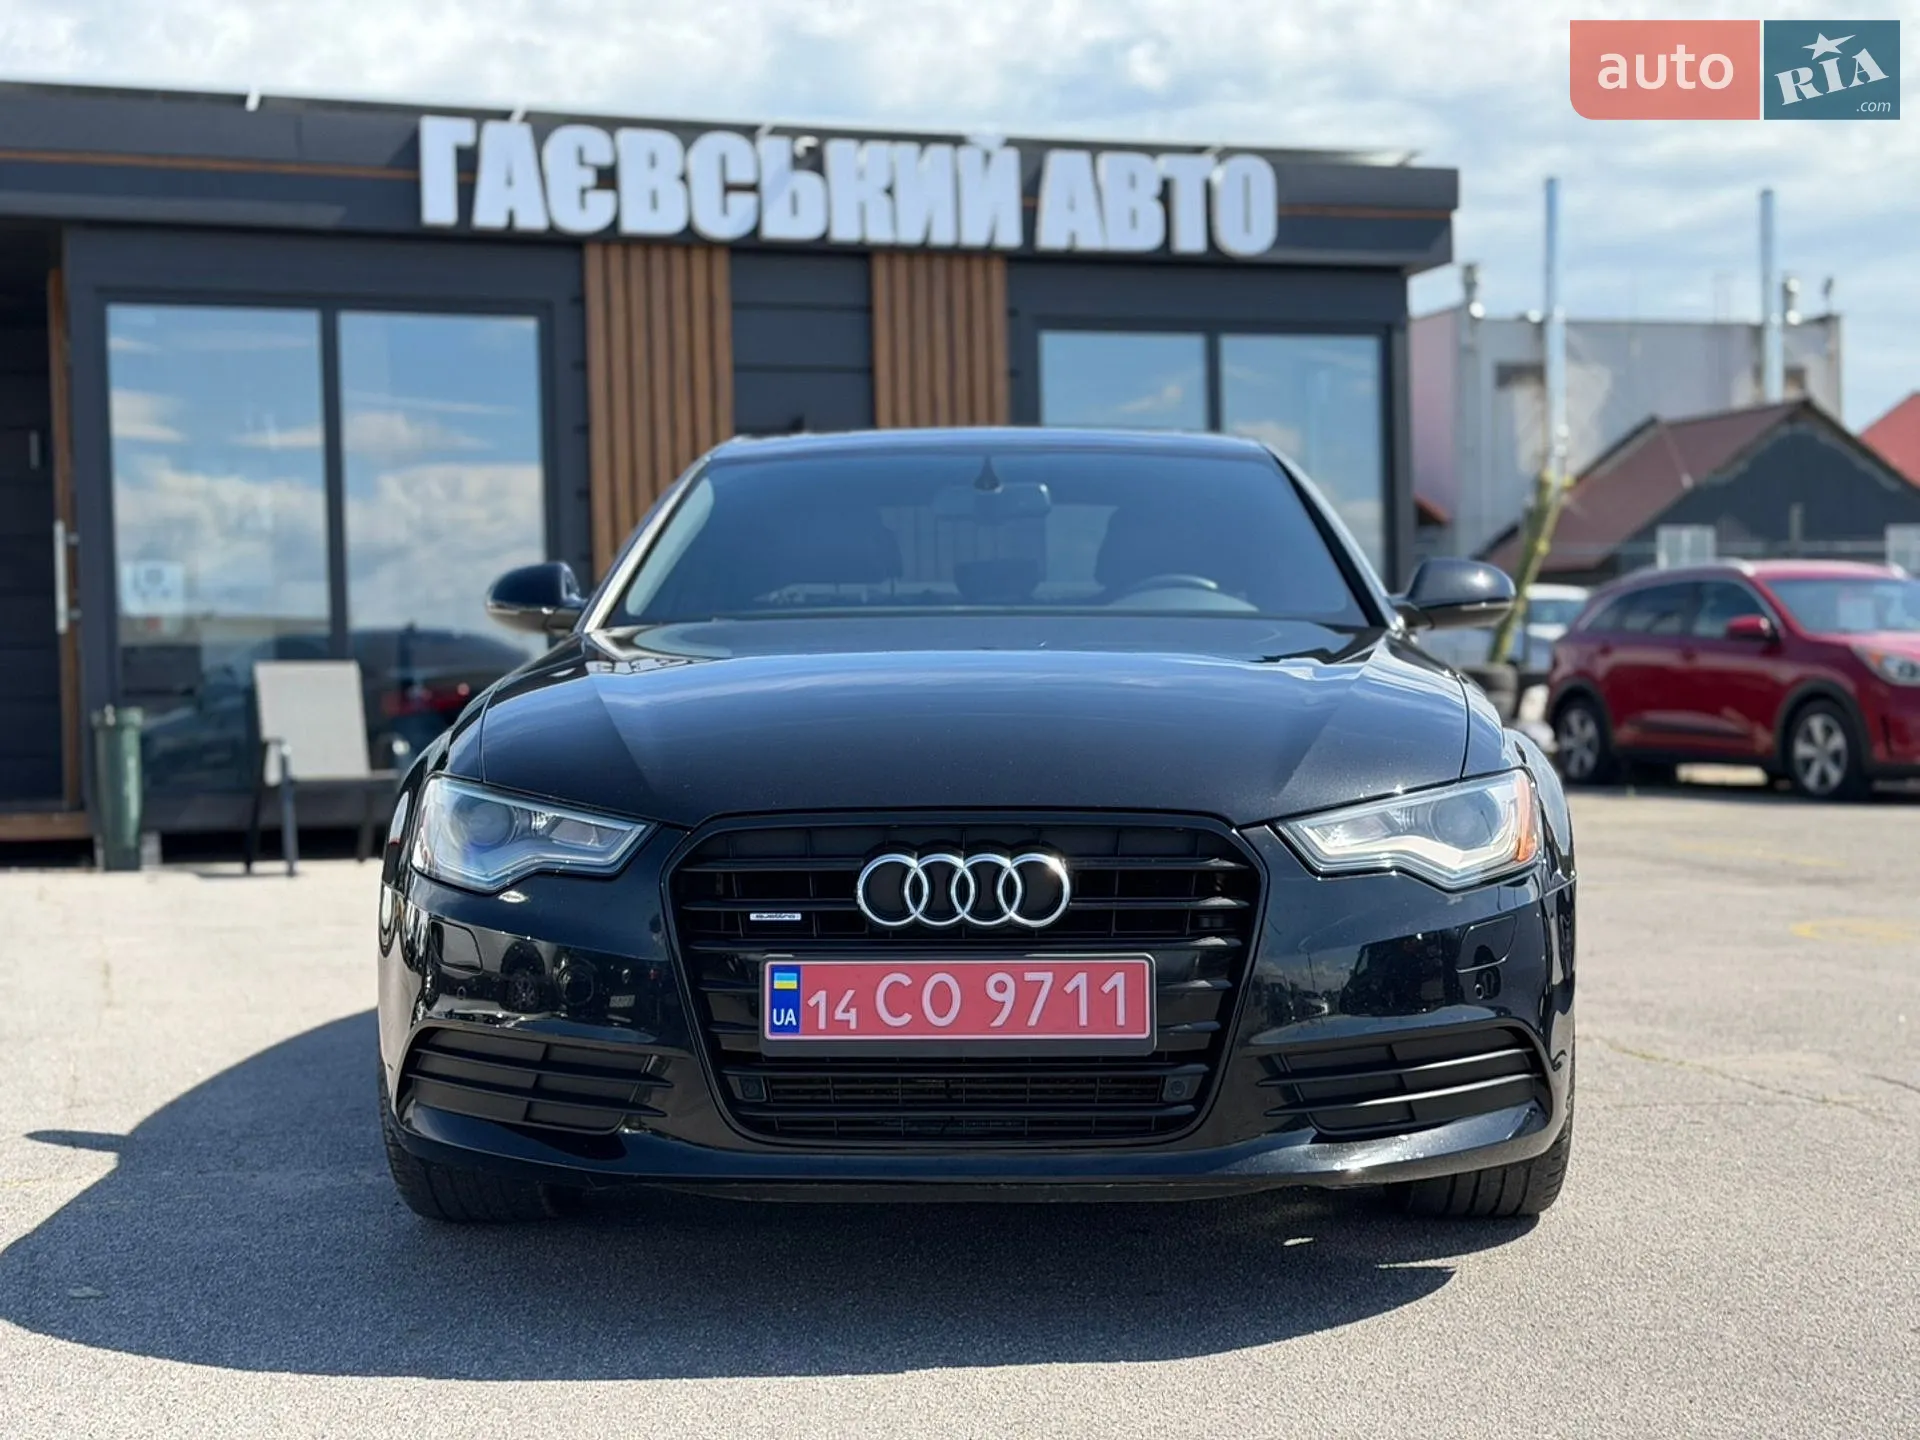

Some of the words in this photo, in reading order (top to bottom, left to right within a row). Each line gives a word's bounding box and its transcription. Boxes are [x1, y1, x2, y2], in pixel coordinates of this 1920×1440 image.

[418, 114, 1024, 250] ГАЄВСЬКИЙ
[1035, 148, 1279, 258] АВТО
[772, 1008, 797, 1027] UA
[807, 989, 859, 1030] 14
[874, 972, 962, 1028] CO
[985, 971, 1128, 1028] 9711
